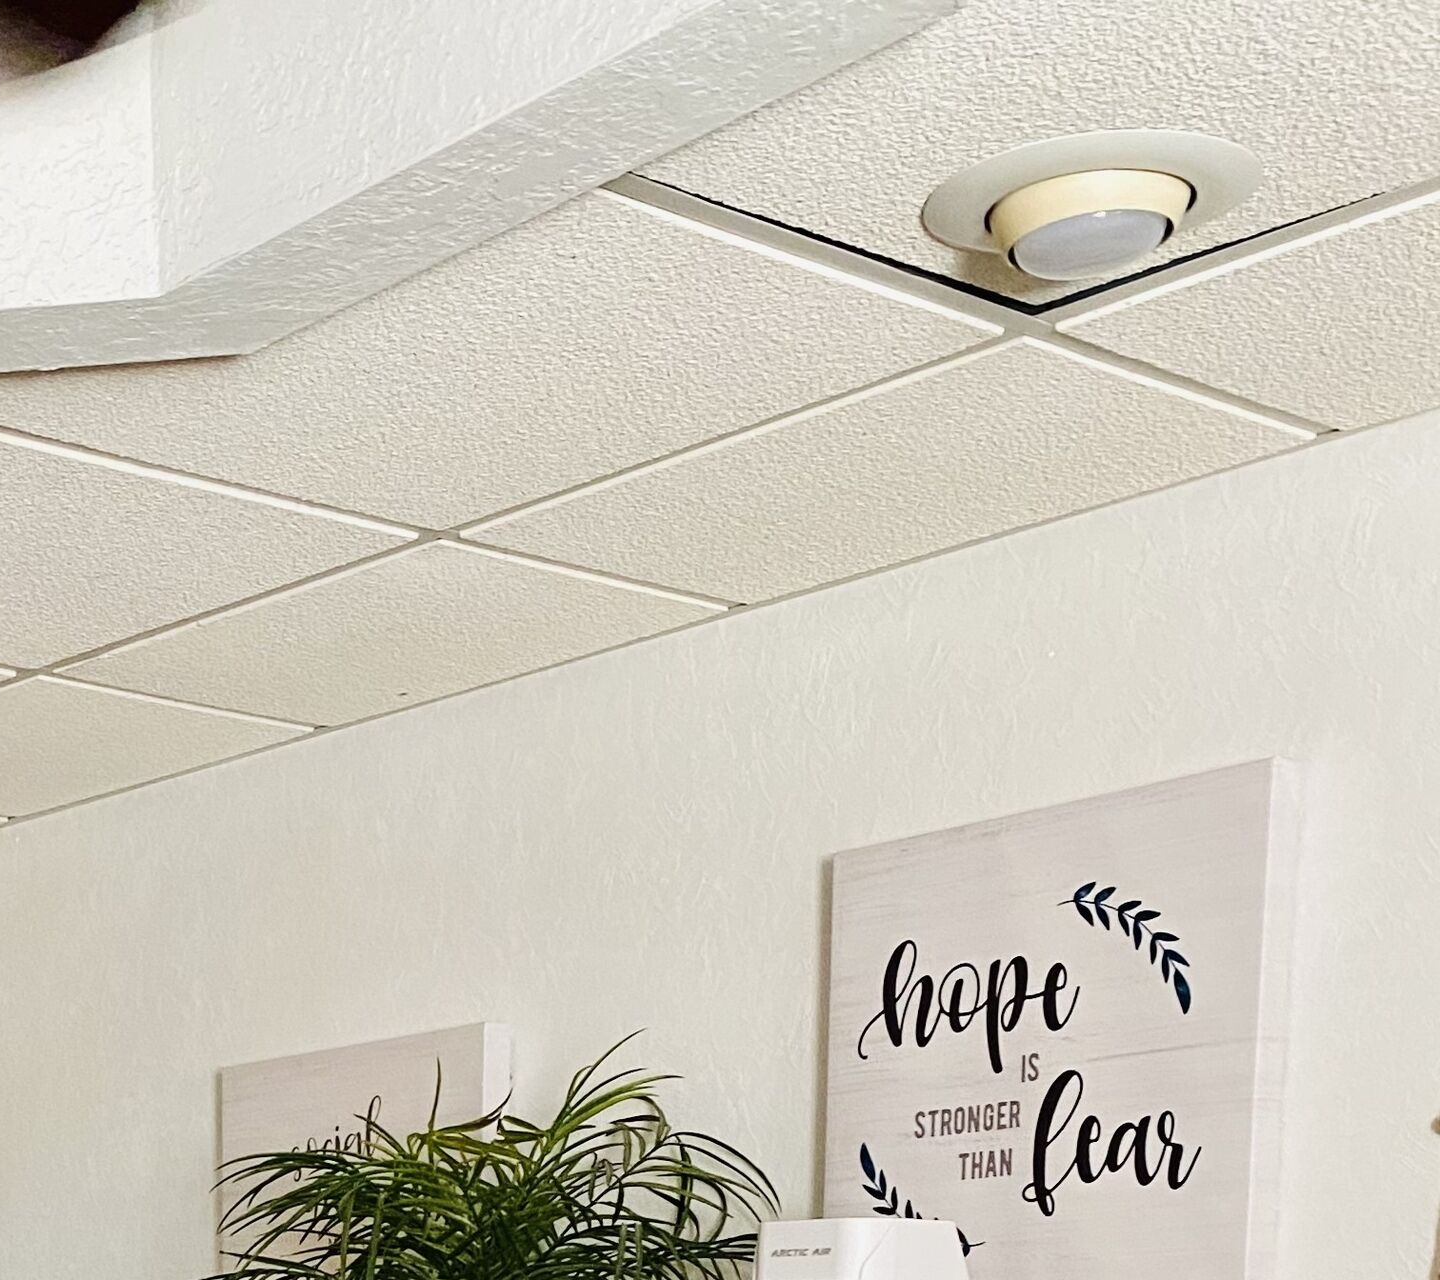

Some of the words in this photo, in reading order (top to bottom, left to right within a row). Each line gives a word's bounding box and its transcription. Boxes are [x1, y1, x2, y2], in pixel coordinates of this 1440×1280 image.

[858, 940, 1080, 1074] hope
[1020, 1053, 1040, 1082] IS
[914, 1100, 1021, 1139] STRONGER
[1022, 1069, 1202, 1217] fear
[958, 1147, 1014, 1181] THAN
